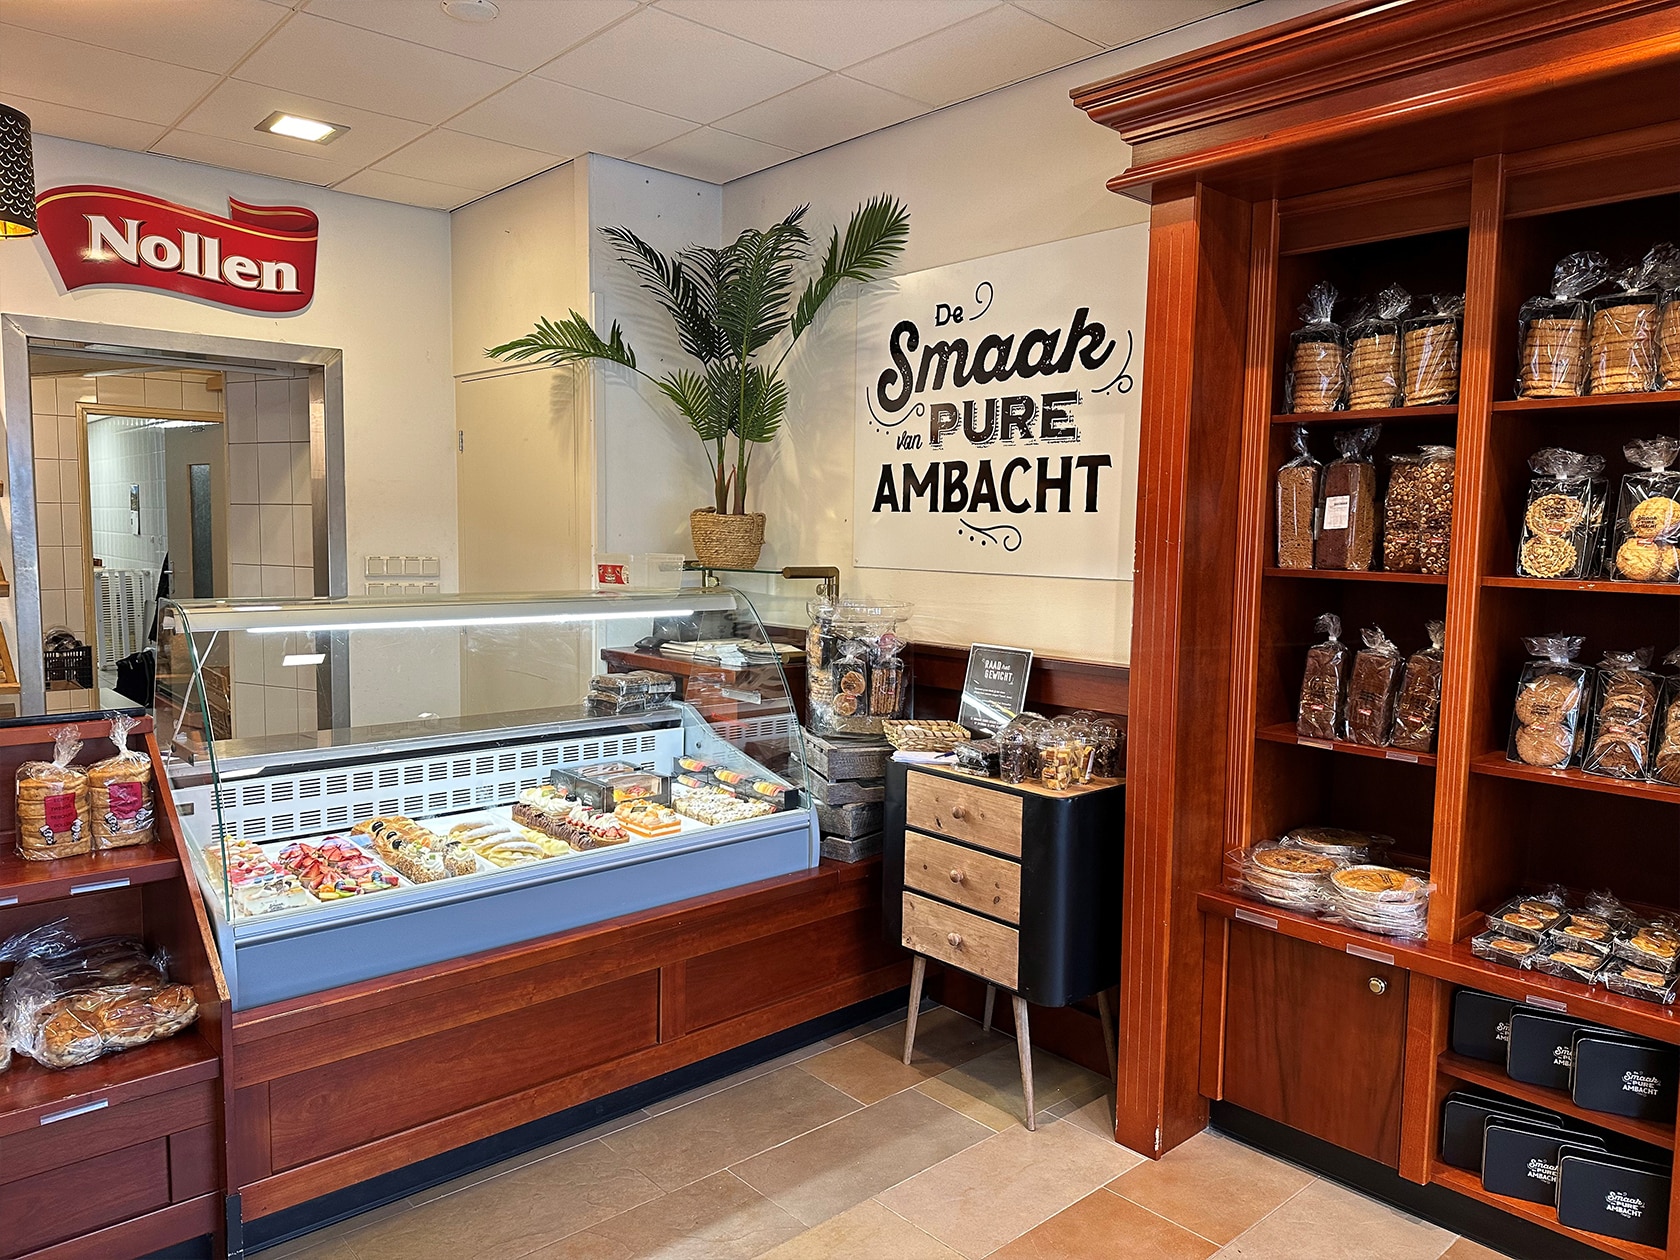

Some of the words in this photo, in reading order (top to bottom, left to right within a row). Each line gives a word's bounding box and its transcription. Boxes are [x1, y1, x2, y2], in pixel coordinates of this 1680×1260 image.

[82, 213, 303, 295] Nollen
[934, 302, 964, 327] De
[876, 307, 1117, 413] Smaak
[895, 430, 923, 452] van
[929, 389, 1083, 451] PURE
[871, 454, 1113, 515] AMBACHT
[984, 659, 1002, 670] RAAD
[984, 669, 1013, 682] GEWICHT
[1622, 1084, 1659, 1096] AMBACHT
[1527, 1171, 1557, 1182] AMBACH
[1606, 1204, 1643, 1217] AMBACHT
